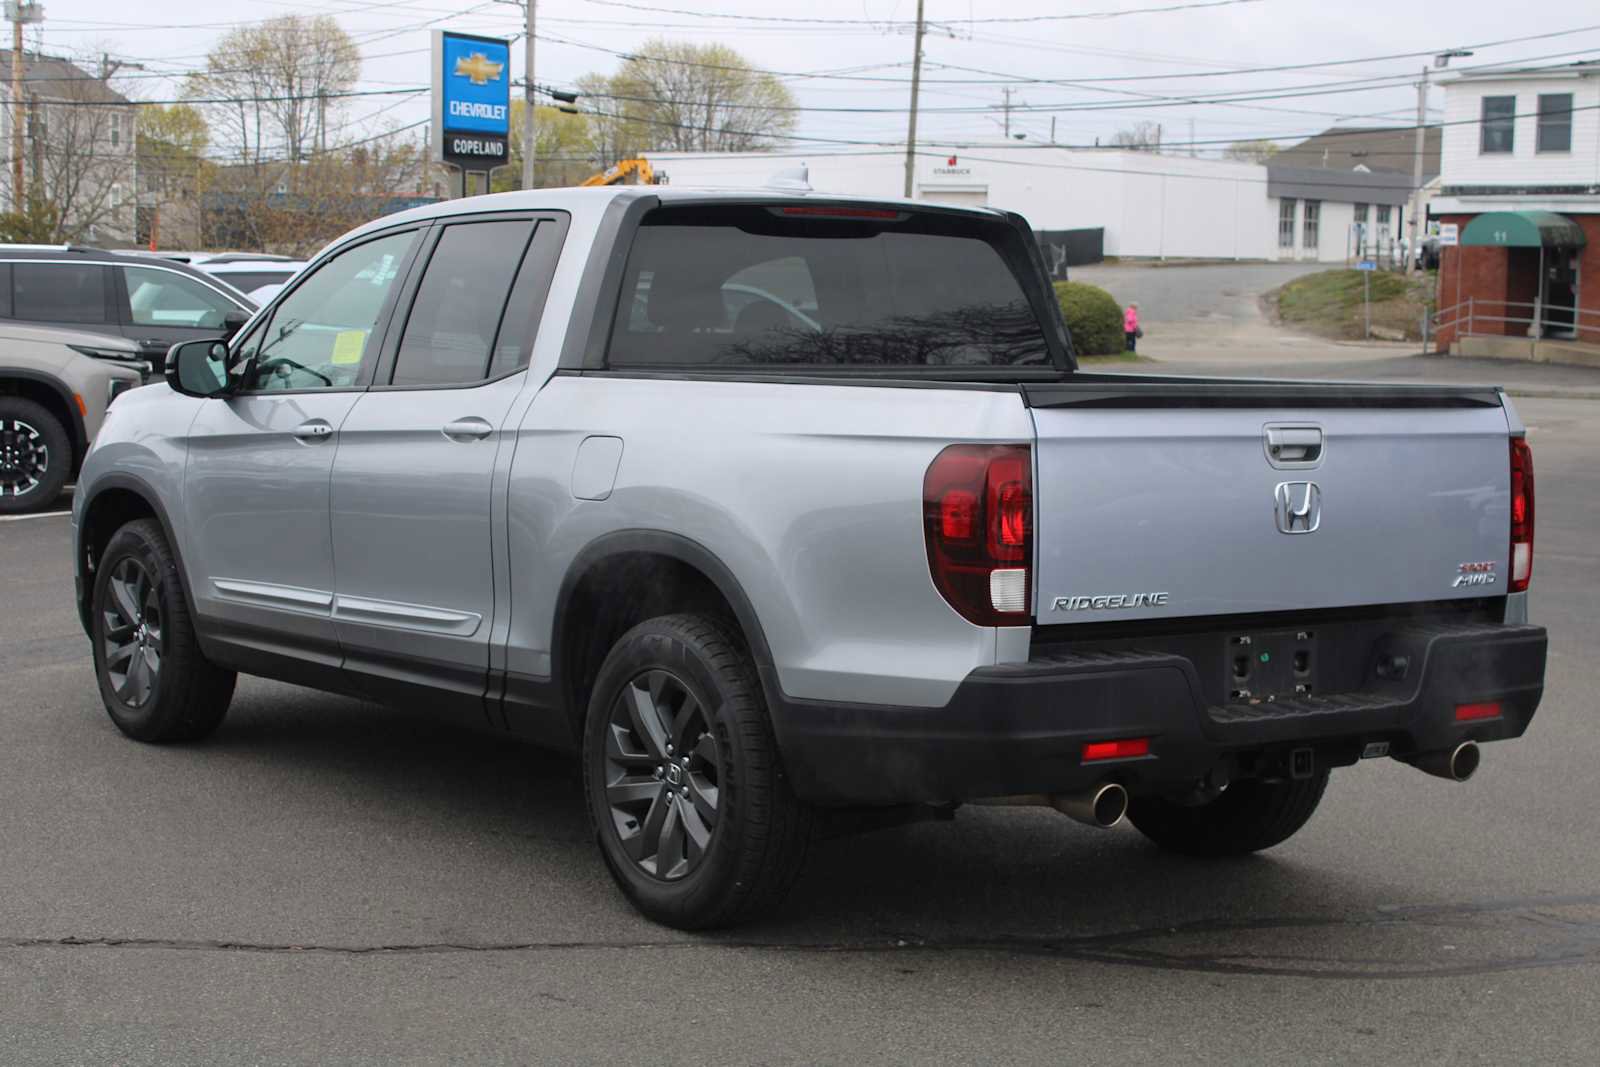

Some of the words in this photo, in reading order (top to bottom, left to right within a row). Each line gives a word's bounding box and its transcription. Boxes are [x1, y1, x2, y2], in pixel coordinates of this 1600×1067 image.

[449, 100, 507, 120] CHEVROLET
[453, 138, 504, 156] COPELAND
[1050, 591, 1169, 611] RIDGELINE
